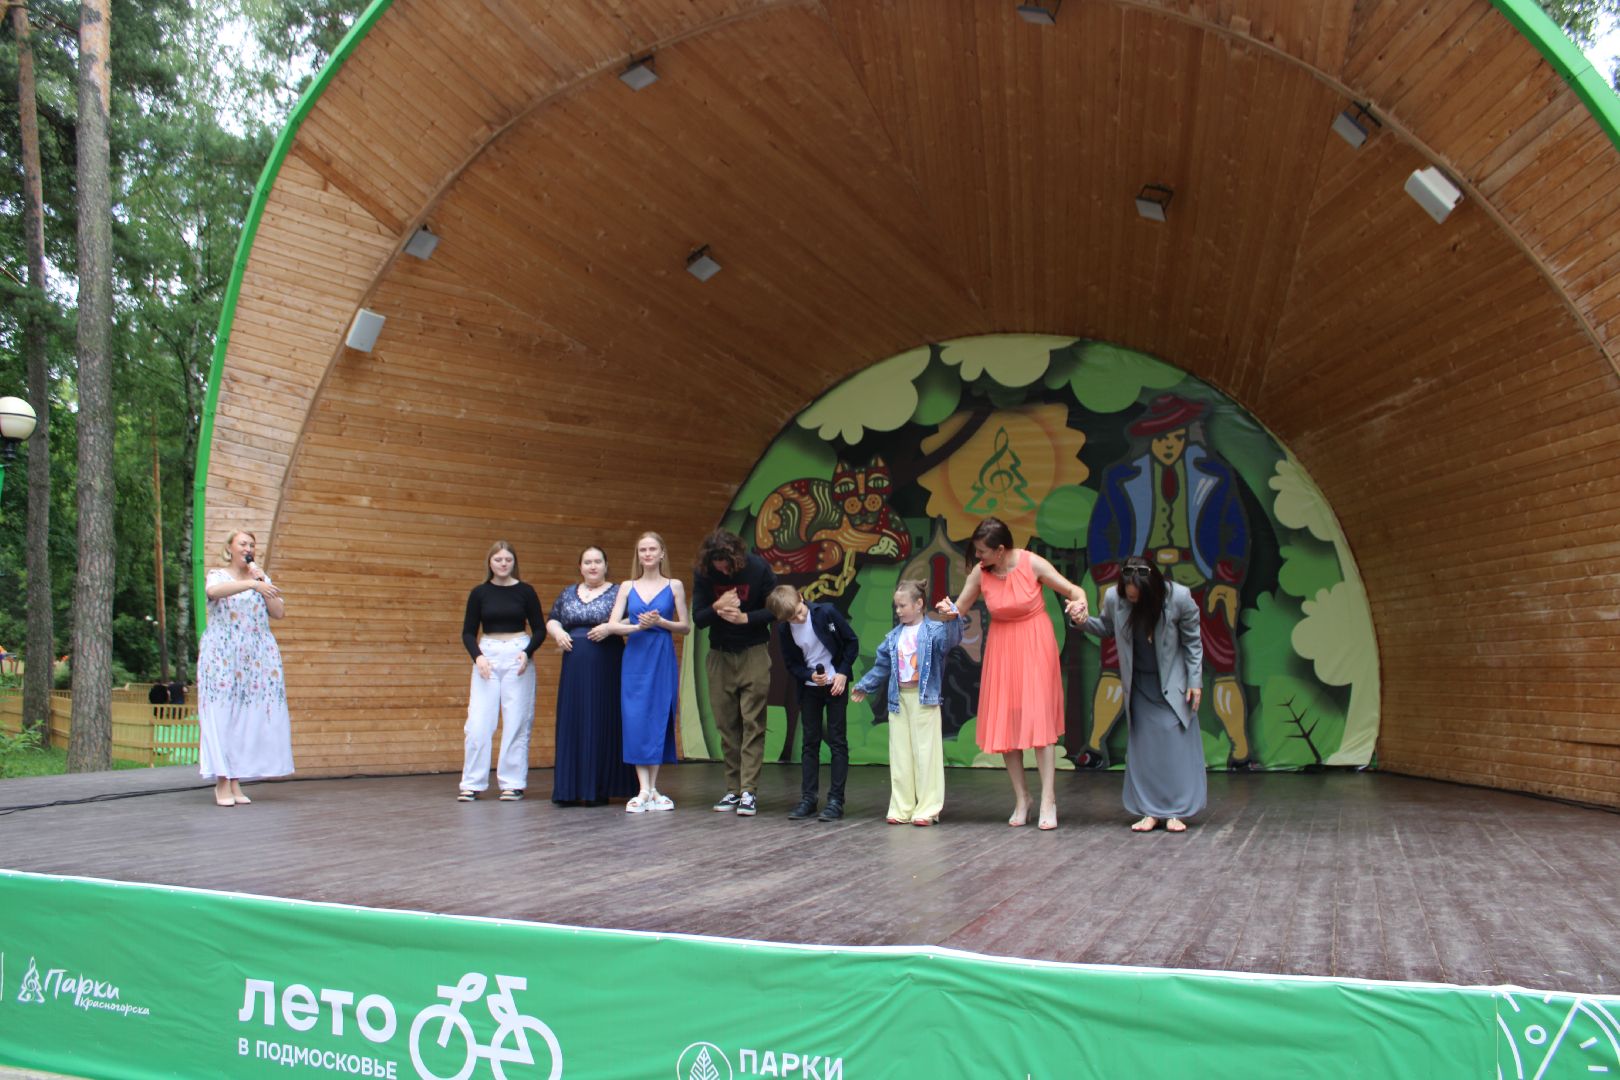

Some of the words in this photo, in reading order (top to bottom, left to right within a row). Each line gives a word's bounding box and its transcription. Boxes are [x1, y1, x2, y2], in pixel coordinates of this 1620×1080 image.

[45, 968, 119, 1006] Парки
[256, 1040, 398, 1080] ПОДМОСКОВЬЕ
[739, 1048, 843, 1080] ПАРКИ
